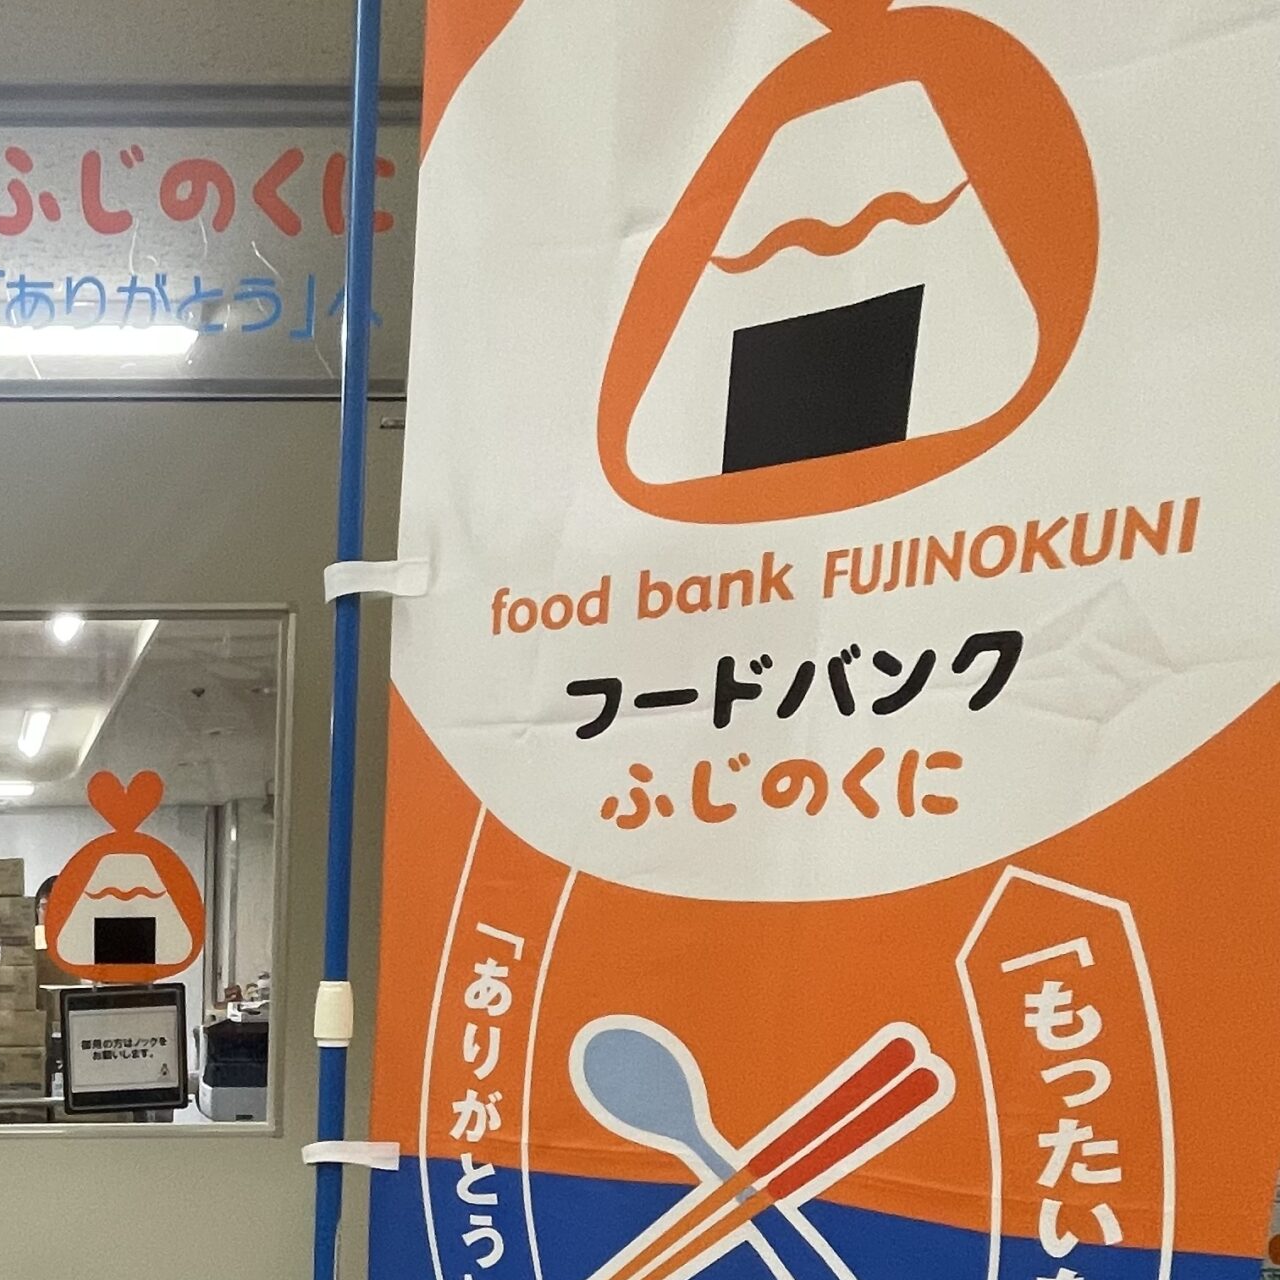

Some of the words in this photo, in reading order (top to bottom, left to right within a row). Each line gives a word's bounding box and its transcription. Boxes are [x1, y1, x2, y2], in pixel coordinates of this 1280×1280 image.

[490, 574, 611, 635] food
[637, 551, 796, 620] bank
[823, 496, 1202, 600] FUJINOKUNI
[566, 630, 1024, 740] フードバンク
[600, 747, 964, 830] ふじのくに
